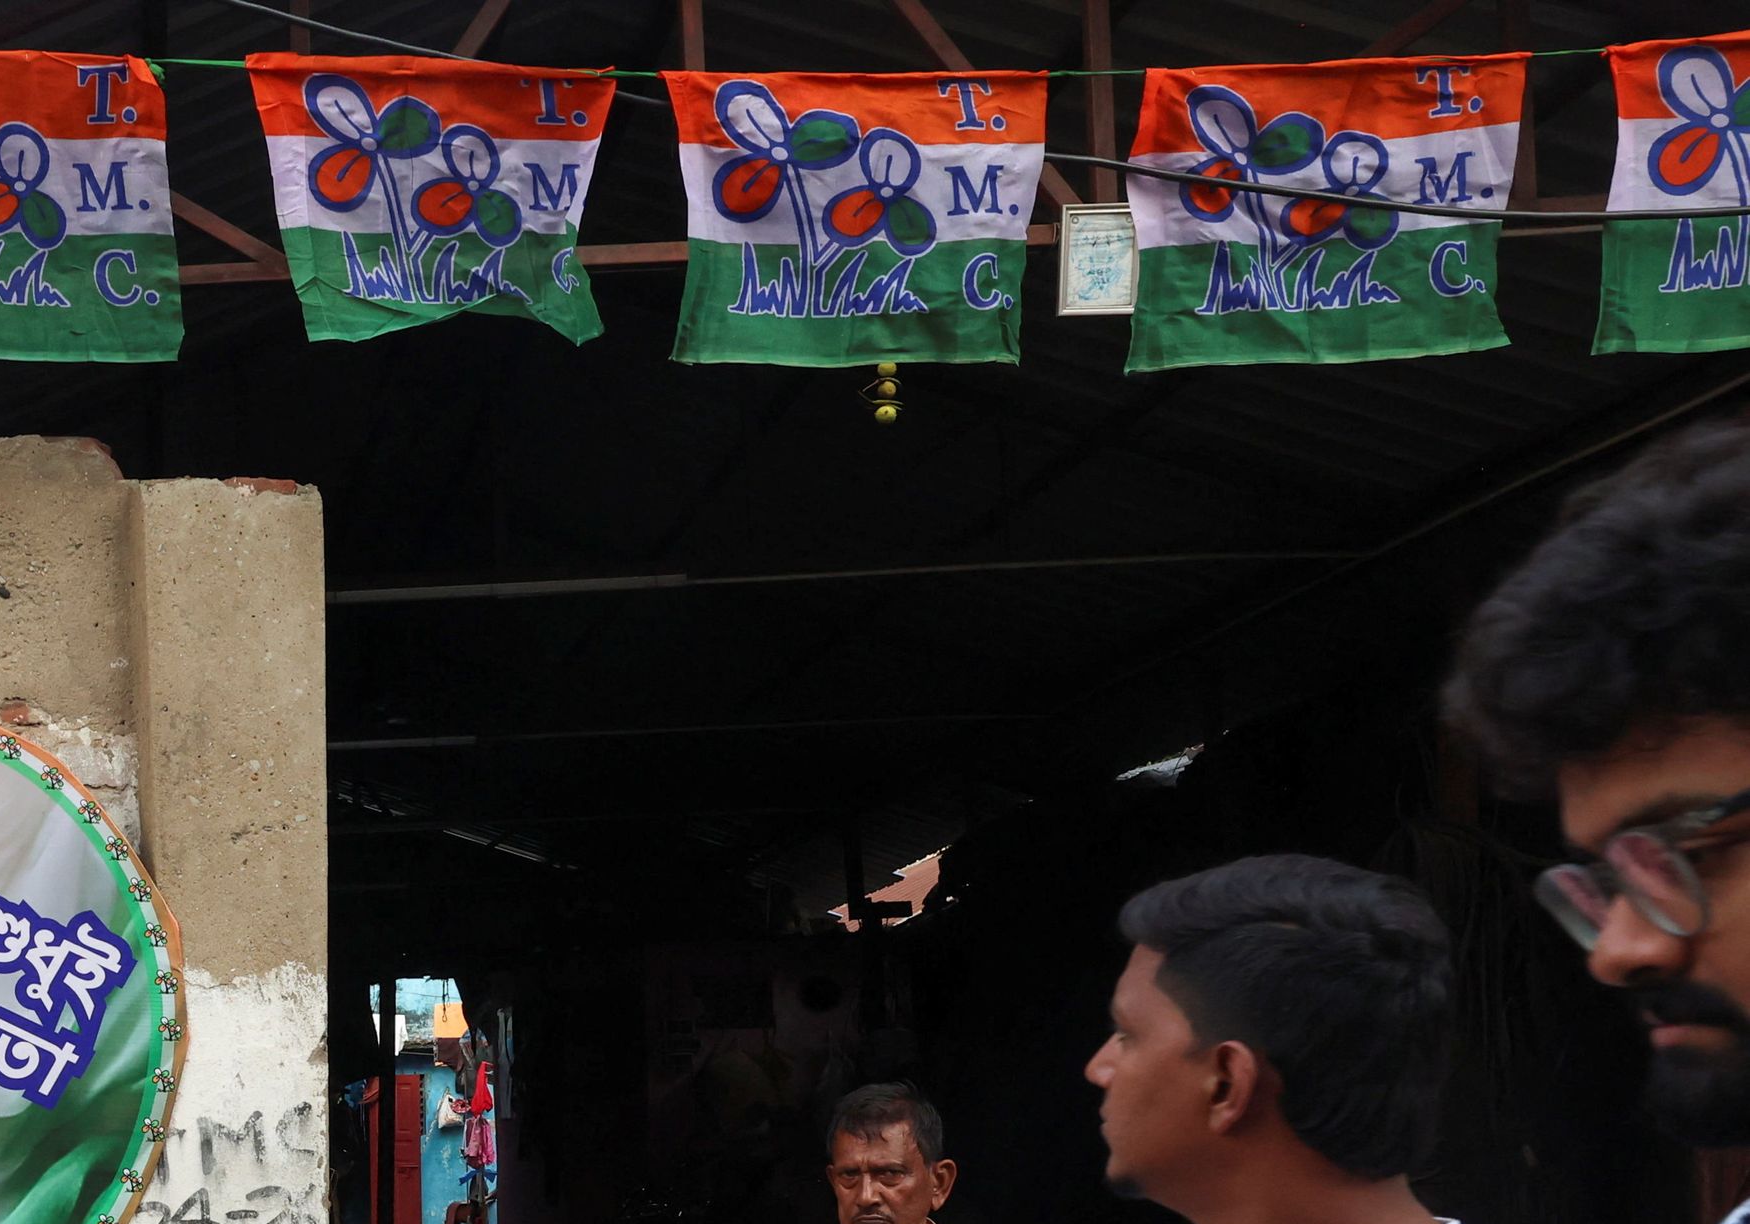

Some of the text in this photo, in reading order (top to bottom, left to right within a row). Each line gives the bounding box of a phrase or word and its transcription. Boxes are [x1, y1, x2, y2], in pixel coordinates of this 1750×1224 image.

[77, 64, 137, 124] T.
[937, 79, 1006, 131] T.
[1416, 65, 1483, 118] T.
[73, 162, 150, 212] M.
[944, 165, 1019, 216] M.
[1413, 151, 1493, 204] M.
[94, 249, 160, 307] C.
[963, 253, 1013, 310] C.
[1428, 240, 1486, 298] C.
